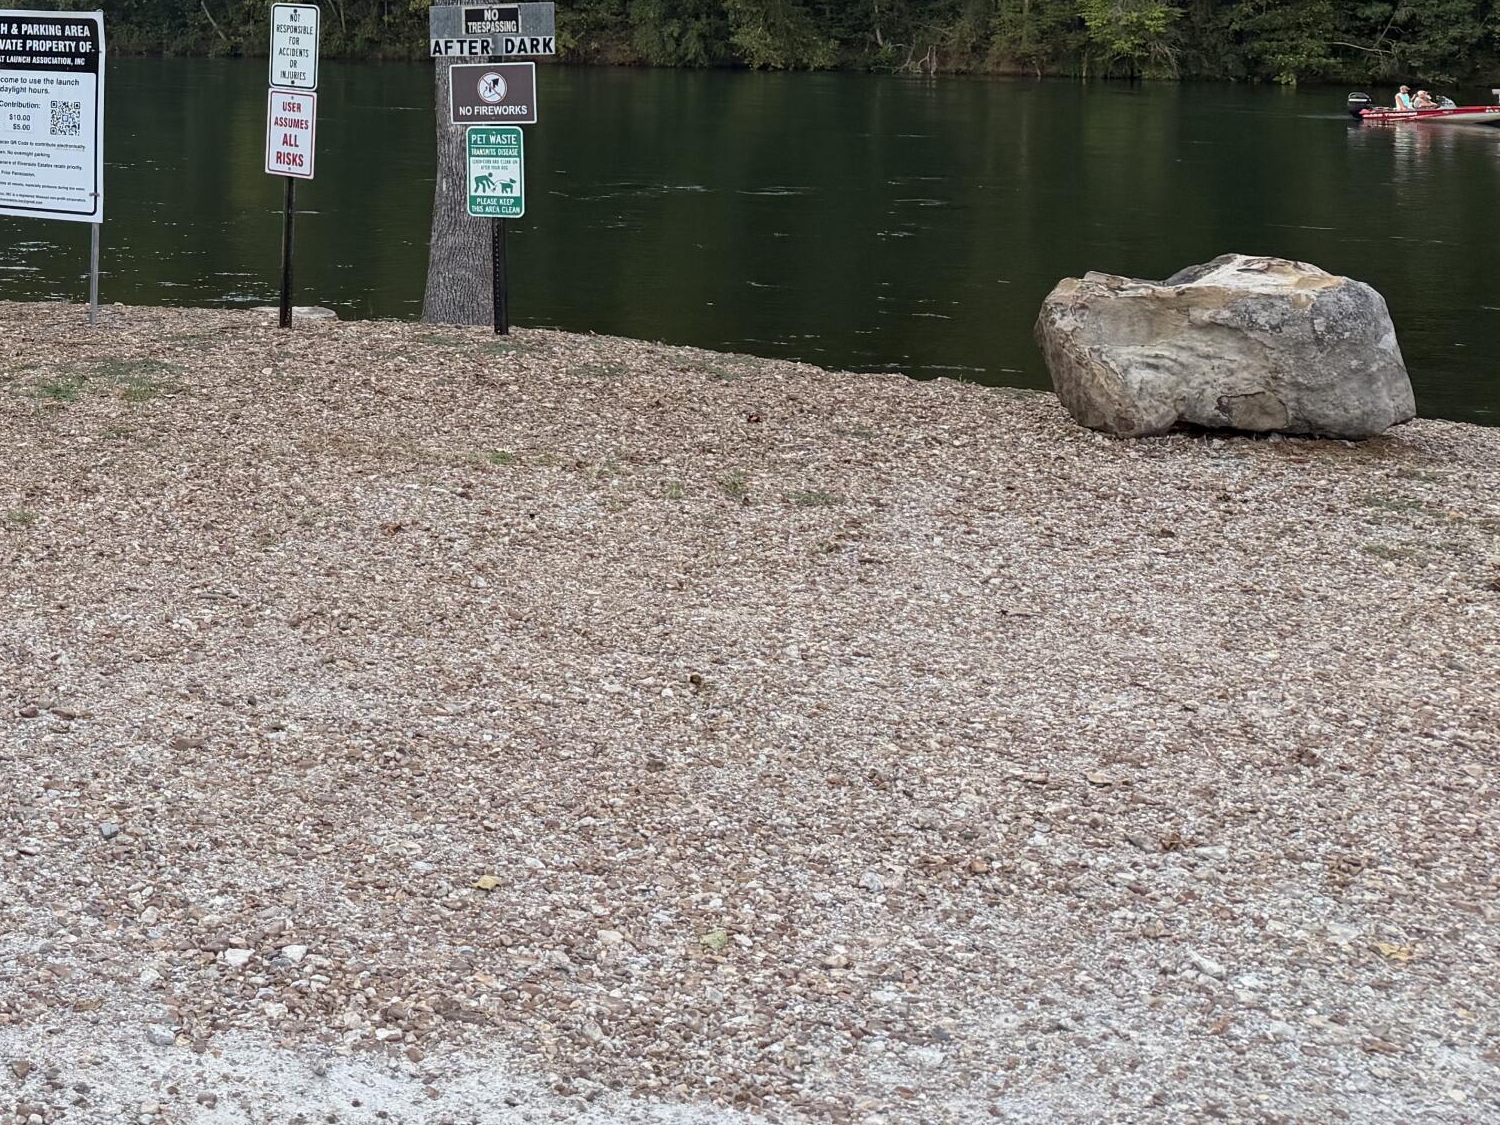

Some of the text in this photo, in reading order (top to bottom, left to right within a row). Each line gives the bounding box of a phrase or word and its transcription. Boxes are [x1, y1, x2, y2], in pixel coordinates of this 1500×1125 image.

[290, 13, 301, 22] NOT
[484, 9, 499, 20] NO
[11, 23, 19, 35] &
[21, 24, 62, 36] PARKING
[64, 25, 91, 37] AREA
[276, 24, 313, 35] RESPONSIBLE
[468, 21, 517, 33] TRESPASSING
[26, 40, 76, 52] PROPERTY
[288, 36, 300, 46] FOR
[432, 37, 553, 55] AFTER DARK
[278, 48, 309, 58] ACCIDENTS
[6, 55, 31, 64] LAUNCH
[32, 56, 74, 66] ASSOCIATION,
[74, 58, 86, 66] INC
[289, 59, 298, 69] OR
[20, 76, 28, 84] to
[43, 77, 55, 85] the
[56, 78, 80, 86] launch
[280, 71, 306, 81] INJURIES
[0, 85, 27, 95] daylight
[282, 101, 302, 113] USER
[459, 105, 528, 116] NO FIREWORKS
[9, 113, 31, 121] $10.00
[12, 123, 31, 131] $5.00
[274, 116, 309, 130] ASSUMES
[282, 133, 299, 148] ALL
[471, 134, 517, 145] PET WASTE
[498, 148, 518, 156] DISEASE
[275, 151, 304, 168] RISKS
[476, 197, 498, 205] PLEASE
[502, 206, 520, 214] CLEAN
